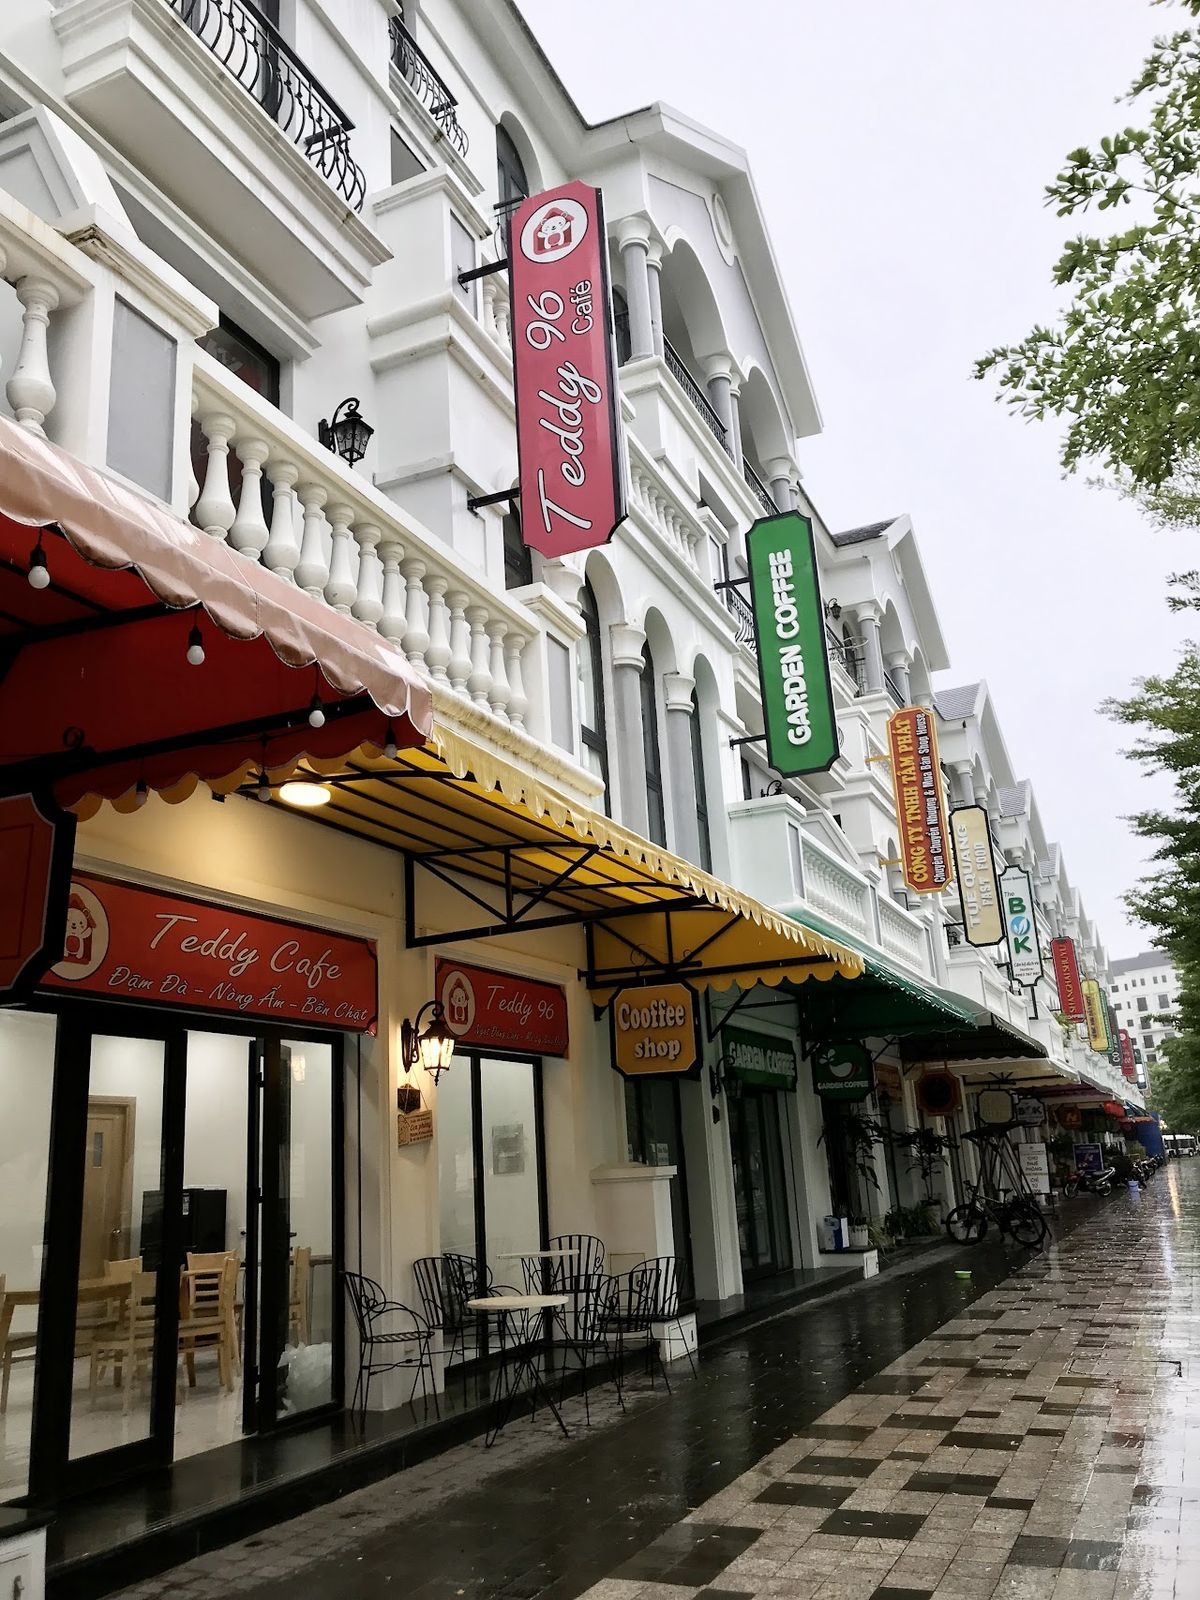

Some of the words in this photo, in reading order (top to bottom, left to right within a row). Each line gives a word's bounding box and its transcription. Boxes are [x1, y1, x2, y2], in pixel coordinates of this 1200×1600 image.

[526, 289, 565, 351] 96
[570, 279, 593, 336] Café
[538, 361, 602, 533] Teddy
[769, 548, 800, 640] COFFEE
[779, 644, 812, 746] GARDEN
[892, 719, 912, 754] PHÁT
[916, 712, 927, 736] House
[918, 734, 930, 754] Shop
[897, 755, 917, 785] TÂM
[922, 770, 935, 788] Mua
[903, 787, 922, 824] TNHH
[908, 826, 923, 845] TY
[909, 847, 929, 883] CÔNG
[974, 841, 989, 872] FOOD
[978, 877, 994, 907] FAST
[150, 912, 260, 977] Teddy
[270, 940, 342, 990] Cafe
[108, 966, 153, 992] Đậm
[160, 974, 188, 995] Đà
[258, 984, 285, 1009] Ấm
[301, 996, 331, 1015] Bền
[485, 985, 534, 1025] Teddy
[538, 1000, 555, 1020] 96
[617, 999, 686, 1032] Cooffee
[633, 1037, 682, 1060] shop
[729, 1040, 766, 1071] GARDEN
[844, 1080, 869, 1089] COFFEE
